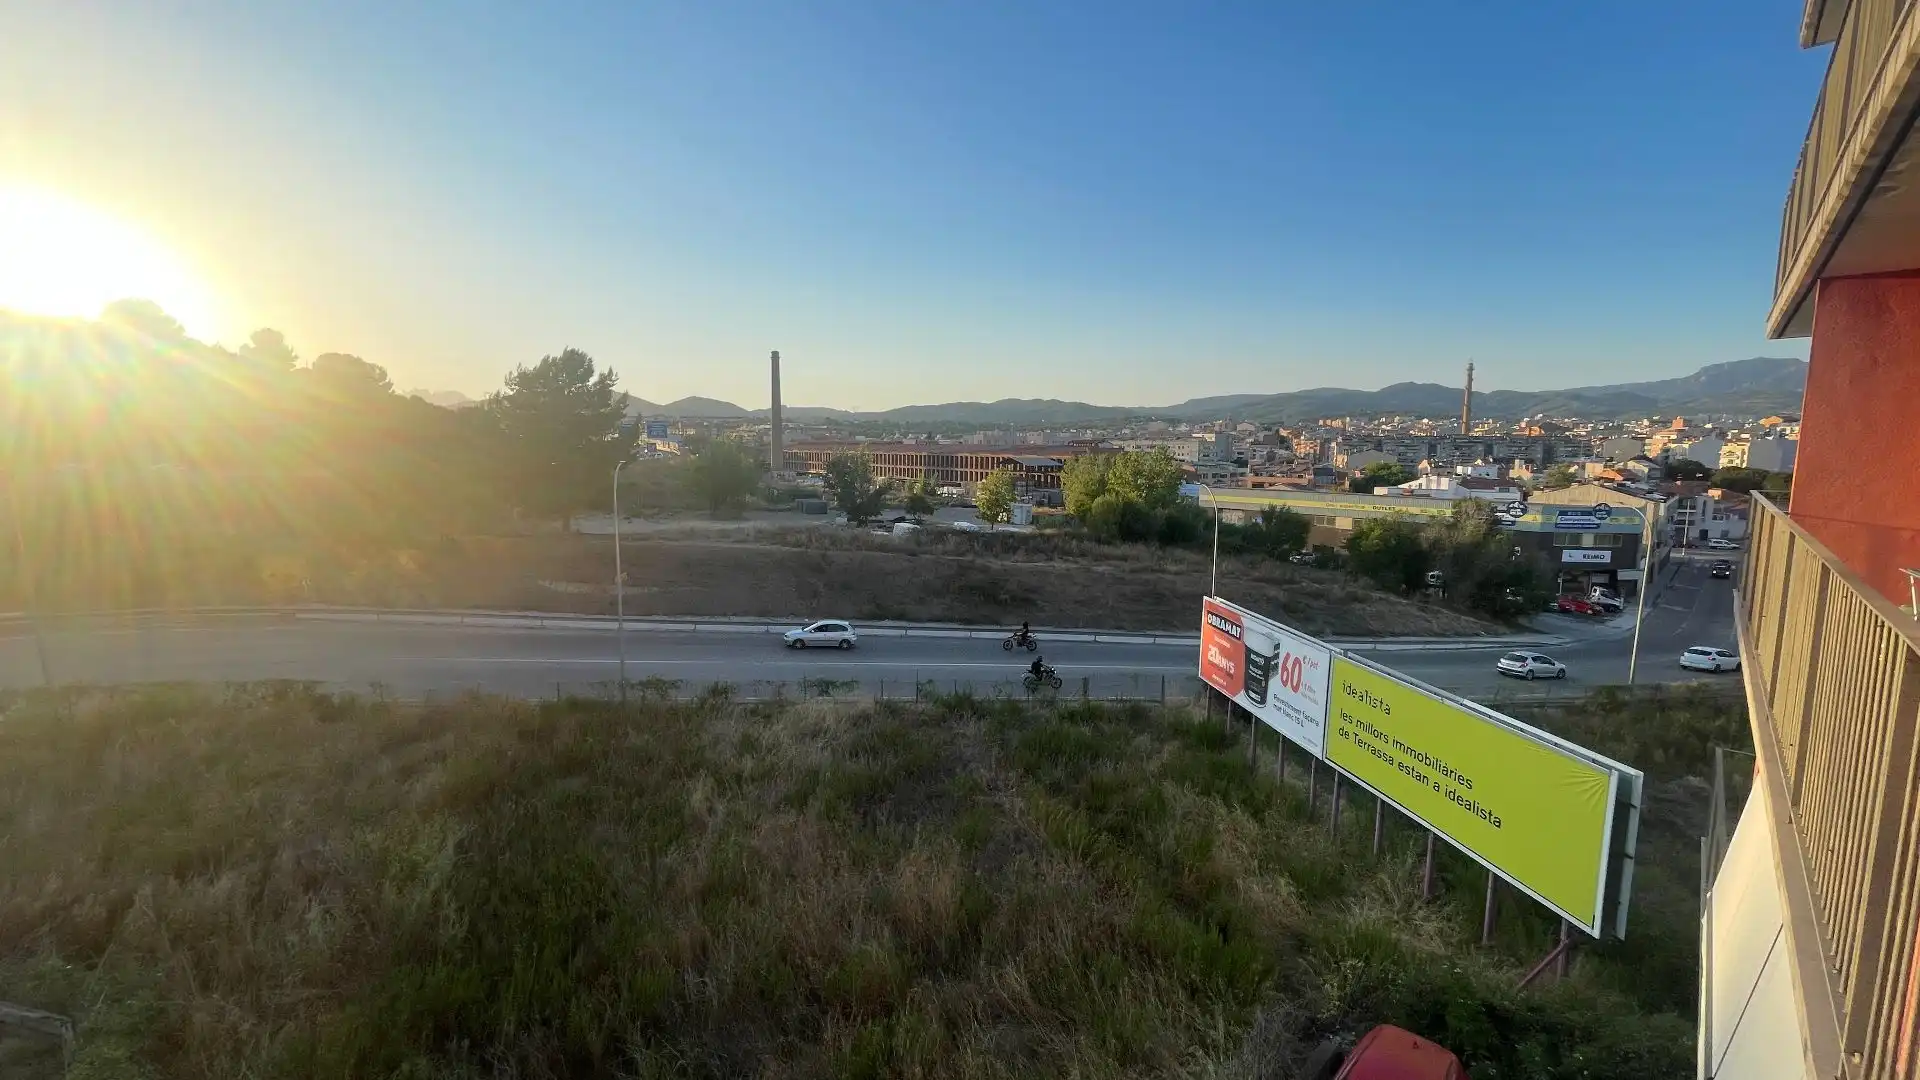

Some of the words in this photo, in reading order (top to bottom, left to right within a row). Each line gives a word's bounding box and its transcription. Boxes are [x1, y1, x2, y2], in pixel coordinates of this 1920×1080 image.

[1207, 613, 1241, 638] OBRAMAT
[1280, 651, 1303, 694] 60
[1342, 680, 1392, 716] idealista
[1340, 708, 1353, 724] les
[1356, 718, 1389, 744] millors
[1392, 736, 1473, 790] immobiliàries
[1338, 725, 1350, 740] de
[1353, 732, 1394, 766] Terrassa
[1398, 761, 1429, 787] estan
[1433, 781, 1441, 793] a
[1444, 785, 1502, 829] idealista
